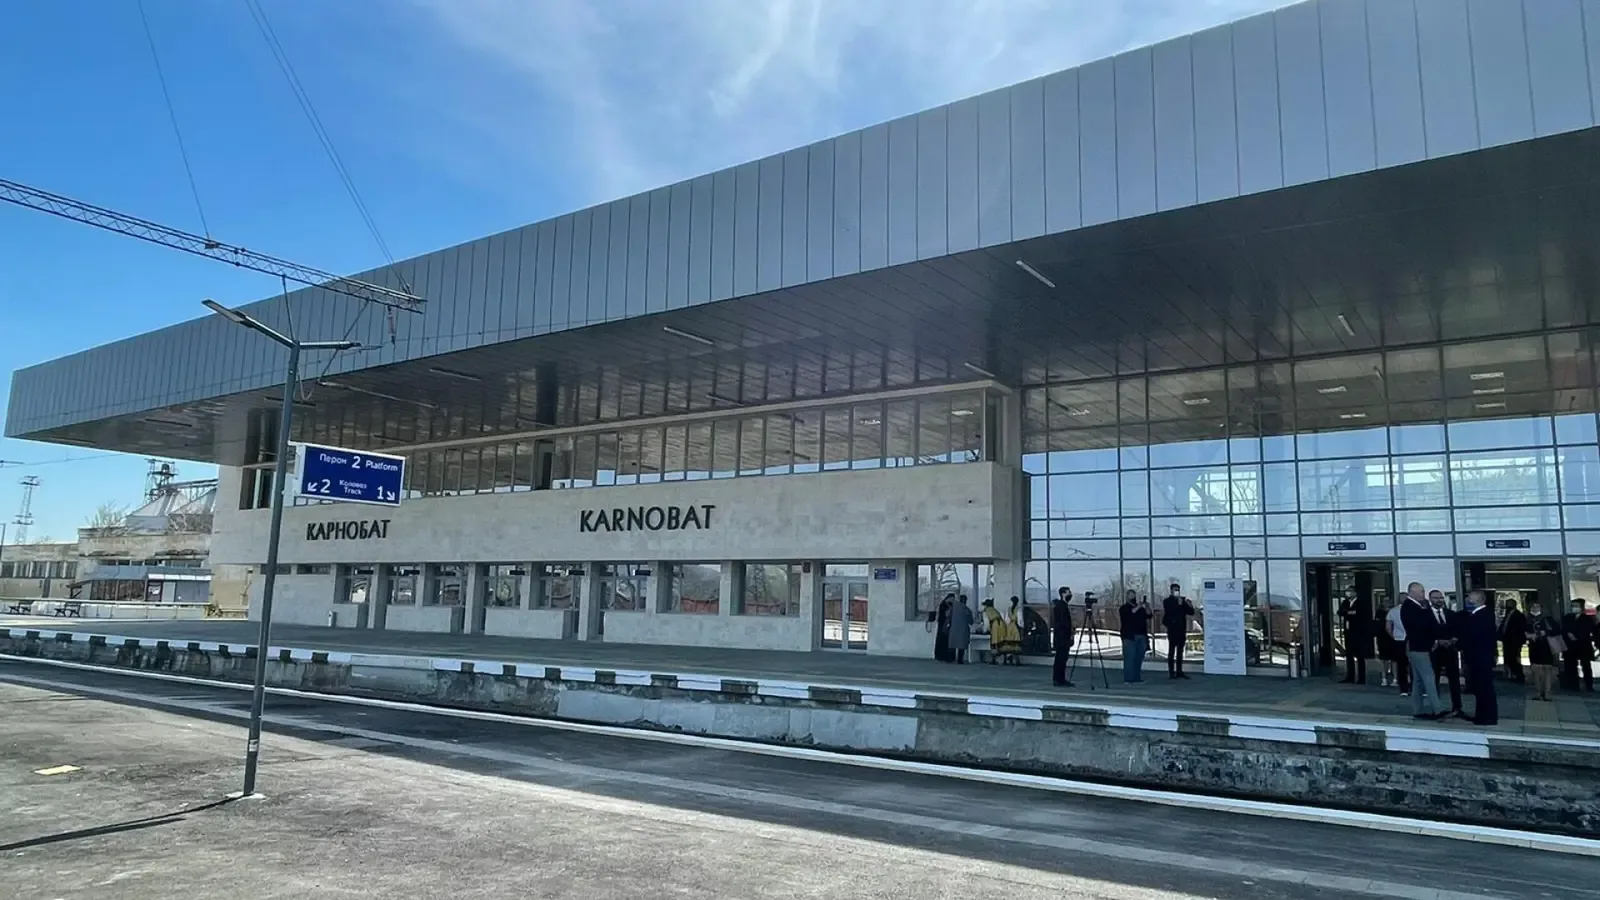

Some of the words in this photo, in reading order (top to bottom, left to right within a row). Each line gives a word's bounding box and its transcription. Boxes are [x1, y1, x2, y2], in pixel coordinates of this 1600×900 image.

[319, 453, 347, 464] Перон
[351, 456, 361, 469] 2
[365, 460, 398, 471] Platform
[320, 479, 331, 493] 2
[344, 487, 362, 495] Track
[377, 486, 384, 500] 1
[580, 505, 716, 532] KARNOBAT
[306, 519, 391, 541] КАРНОБАТ
